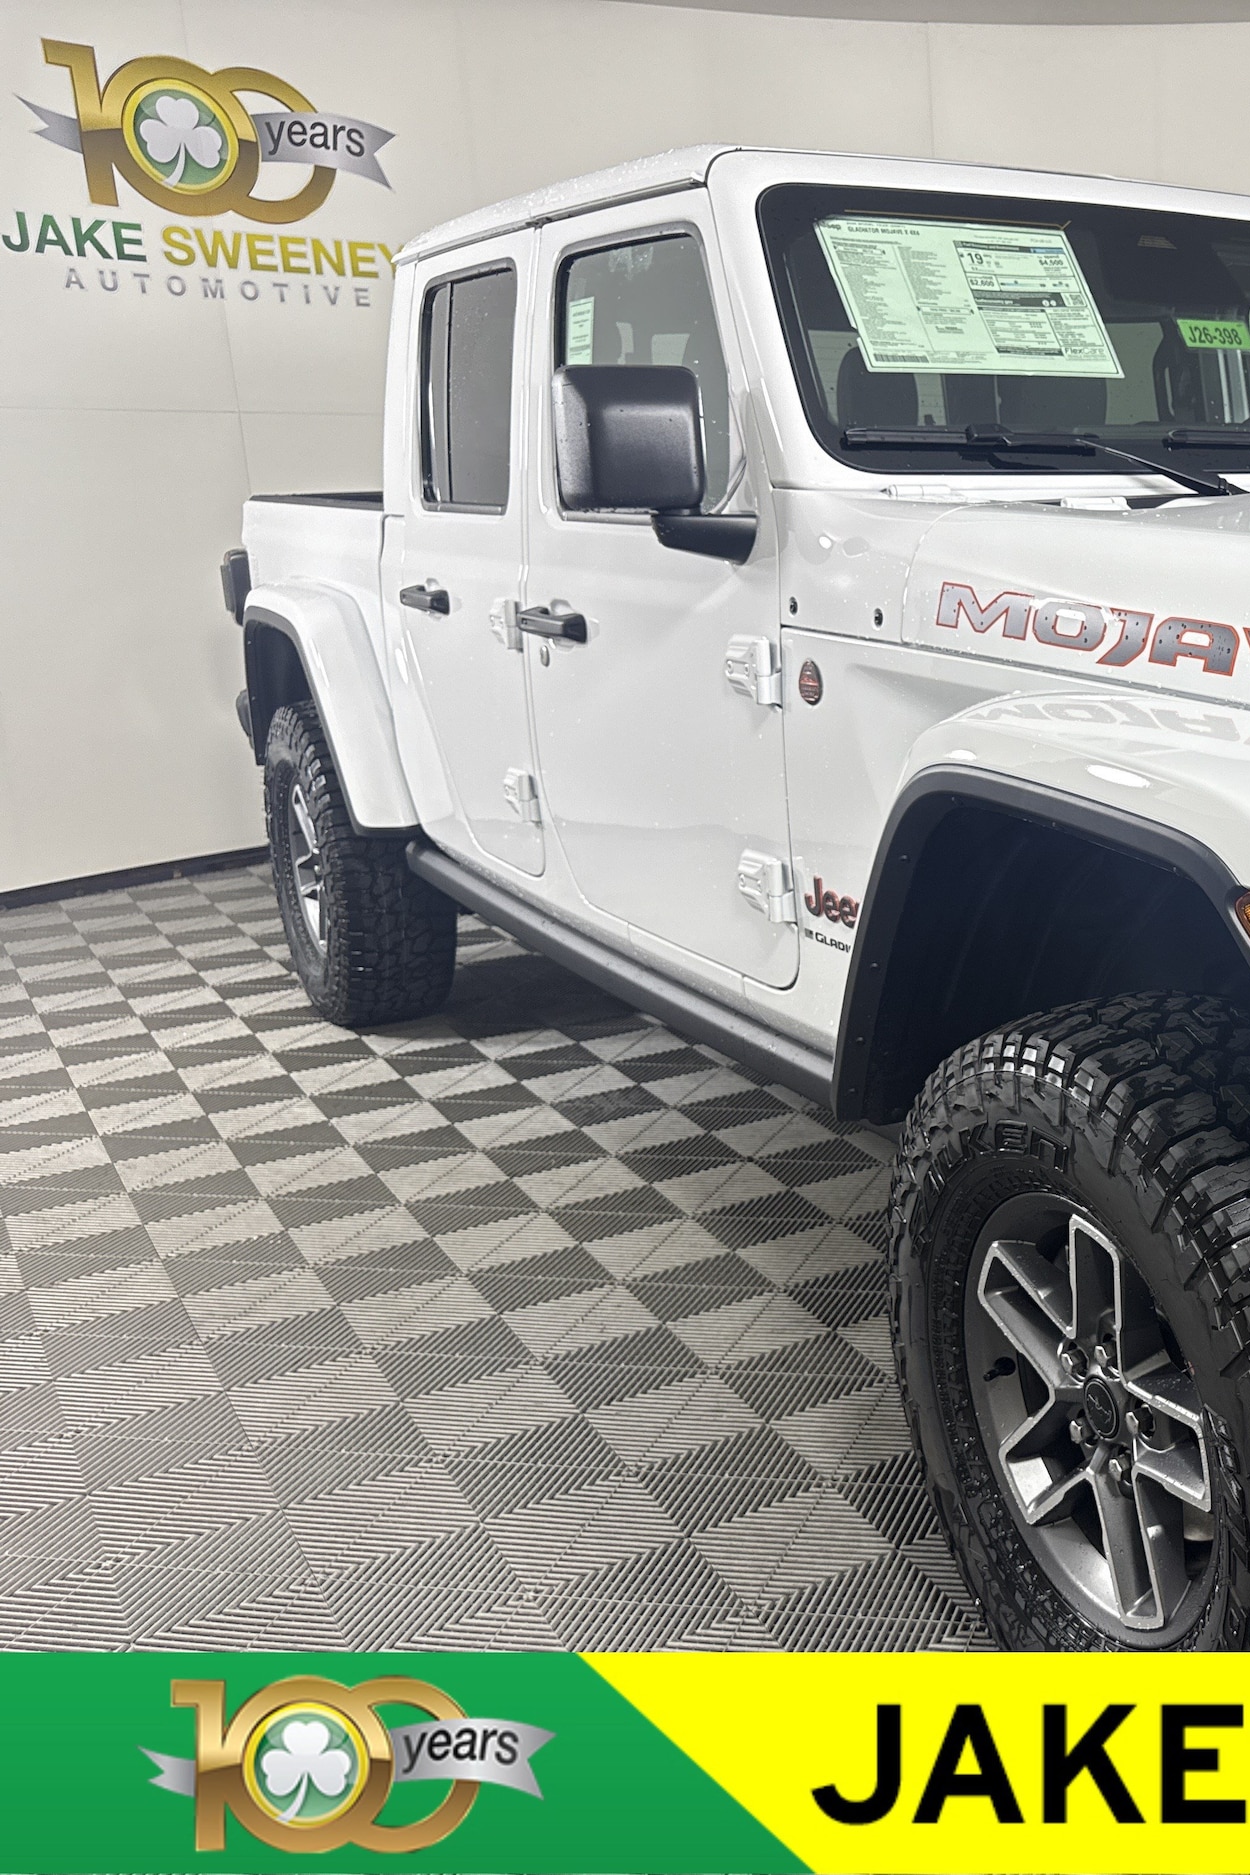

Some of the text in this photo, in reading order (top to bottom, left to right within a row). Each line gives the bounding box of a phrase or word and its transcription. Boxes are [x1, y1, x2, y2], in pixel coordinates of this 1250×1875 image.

[41, 38, 365, 224] 100 years
[2, 211, 147, 262] JAKE
[967, 252, 984, 265] 19
[65, 268, 371, 308] AUTOMOTIVE
[1188, 326, 1242, 346] J26-398
[815, 931, 851, 954] GLADI
